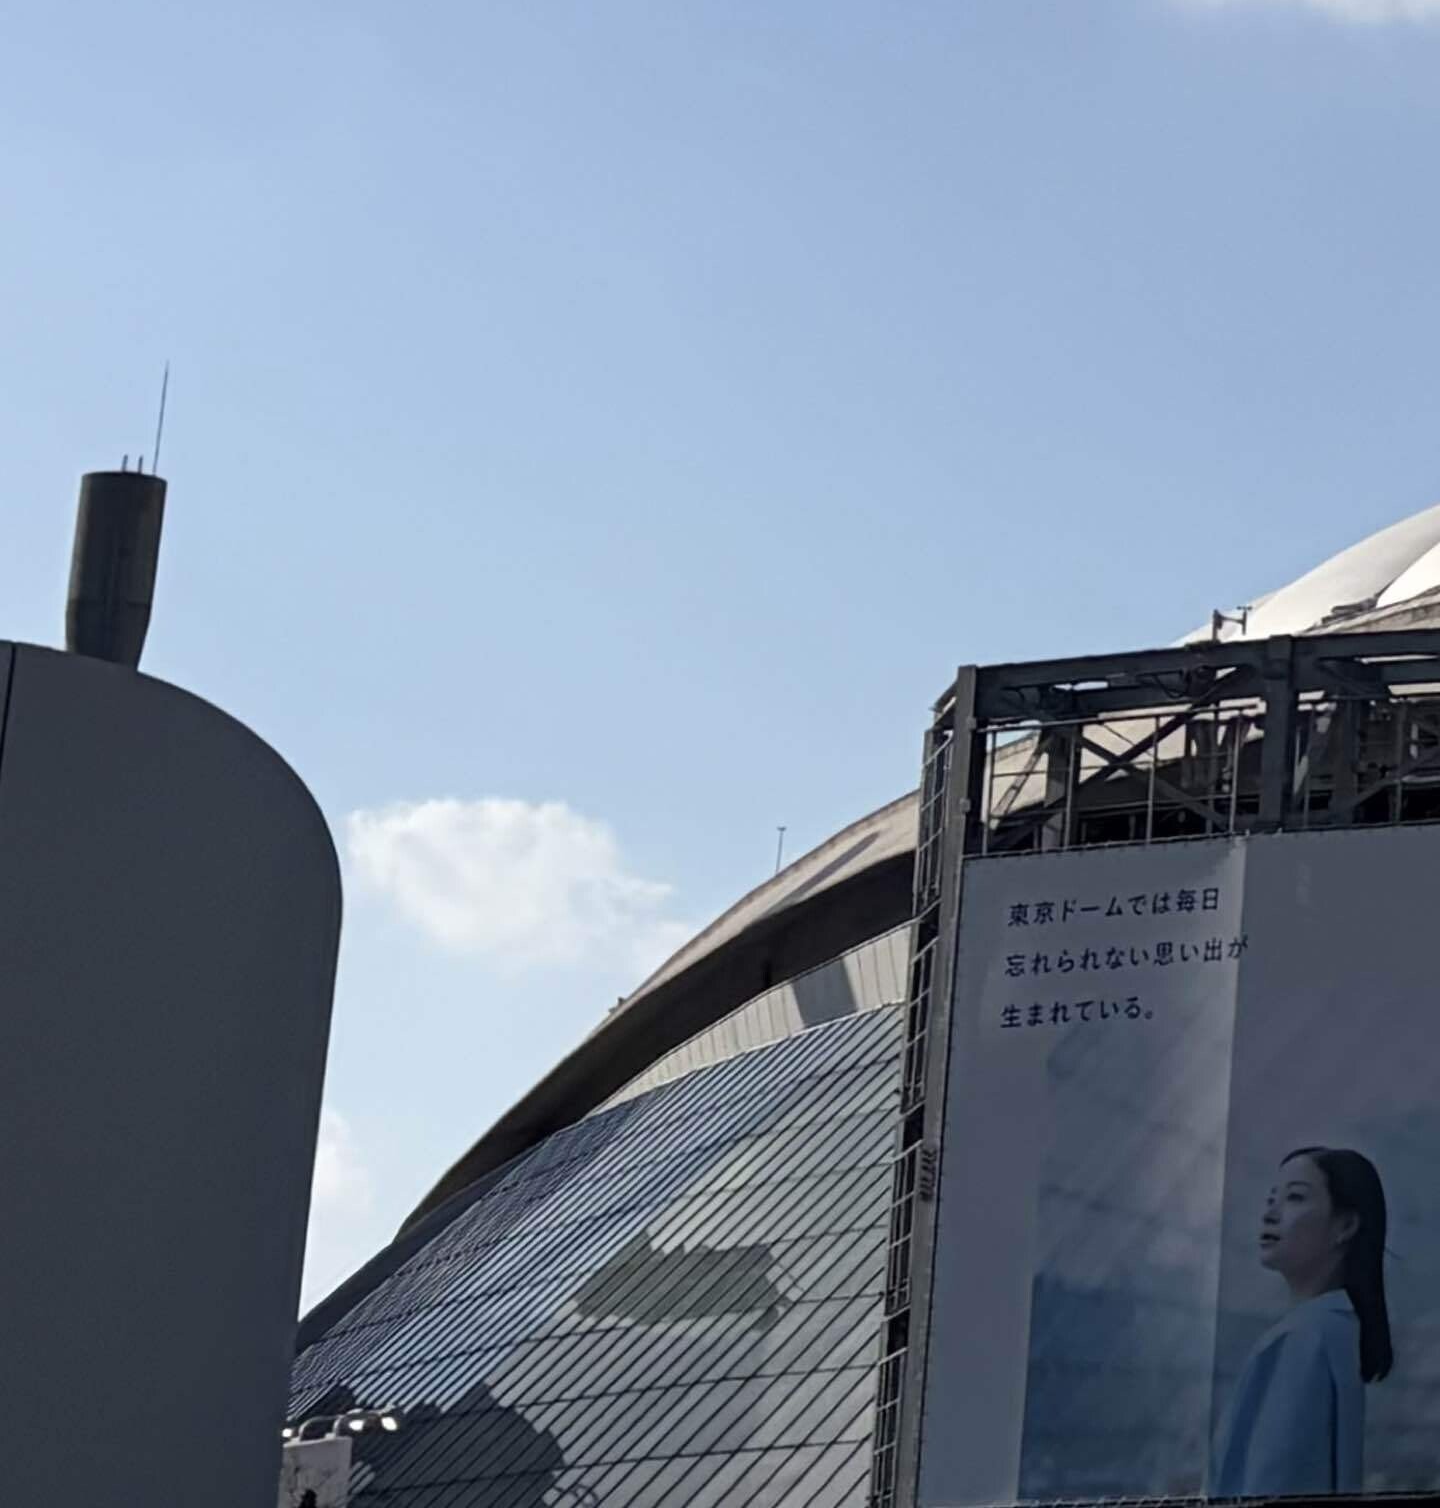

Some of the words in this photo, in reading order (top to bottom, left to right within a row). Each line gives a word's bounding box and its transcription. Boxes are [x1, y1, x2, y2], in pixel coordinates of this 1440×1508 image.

[1007, 887, 1220, 928] 東京ドームでは毎日
[1004, 934, 1249, 978] 忘れられない思い出が
[1000, 996, 1154, 1029] 生まれている。
